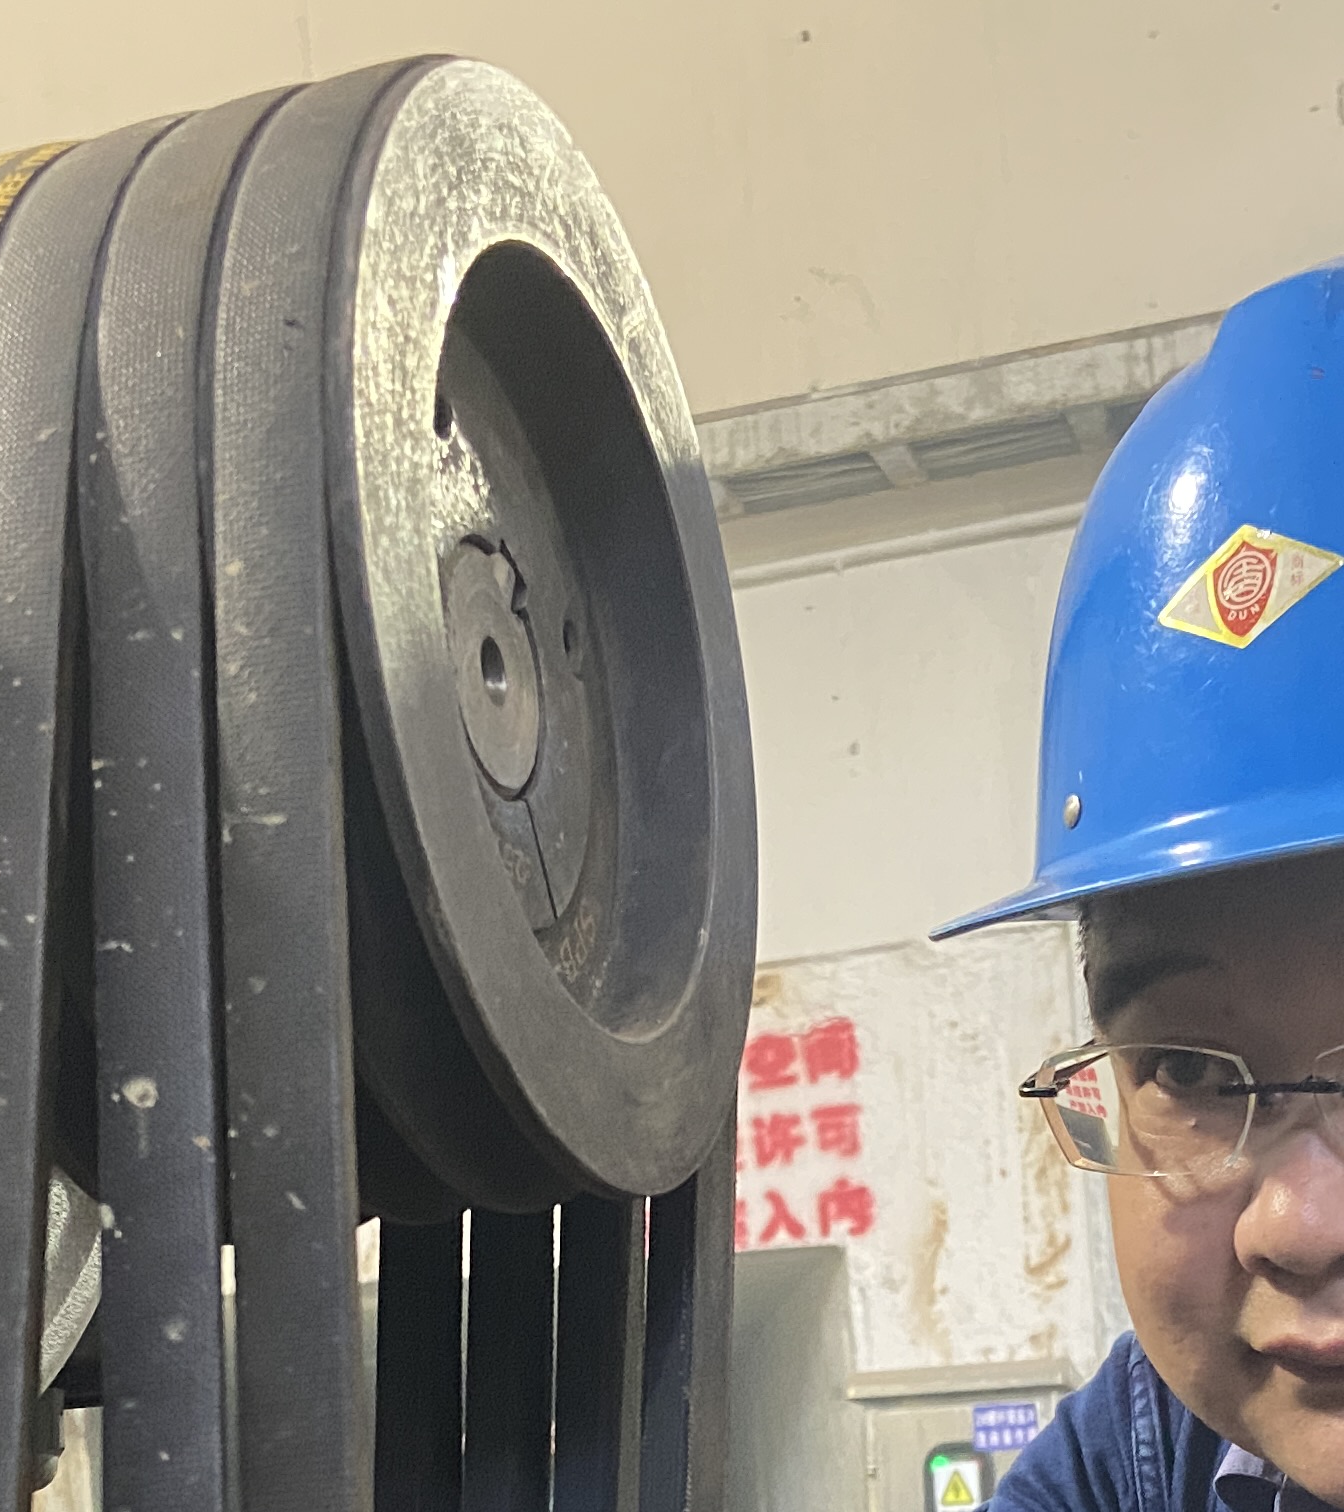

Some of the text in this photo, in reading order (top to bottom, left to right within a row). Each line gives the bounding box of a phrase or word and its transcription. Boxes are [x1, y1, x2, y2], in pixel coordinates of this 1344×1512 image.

[1227, 603, 1261, 621] DUN
[737, 1103, 862, 1173] 许可
[735, 1178, 874, 1250] 入内
